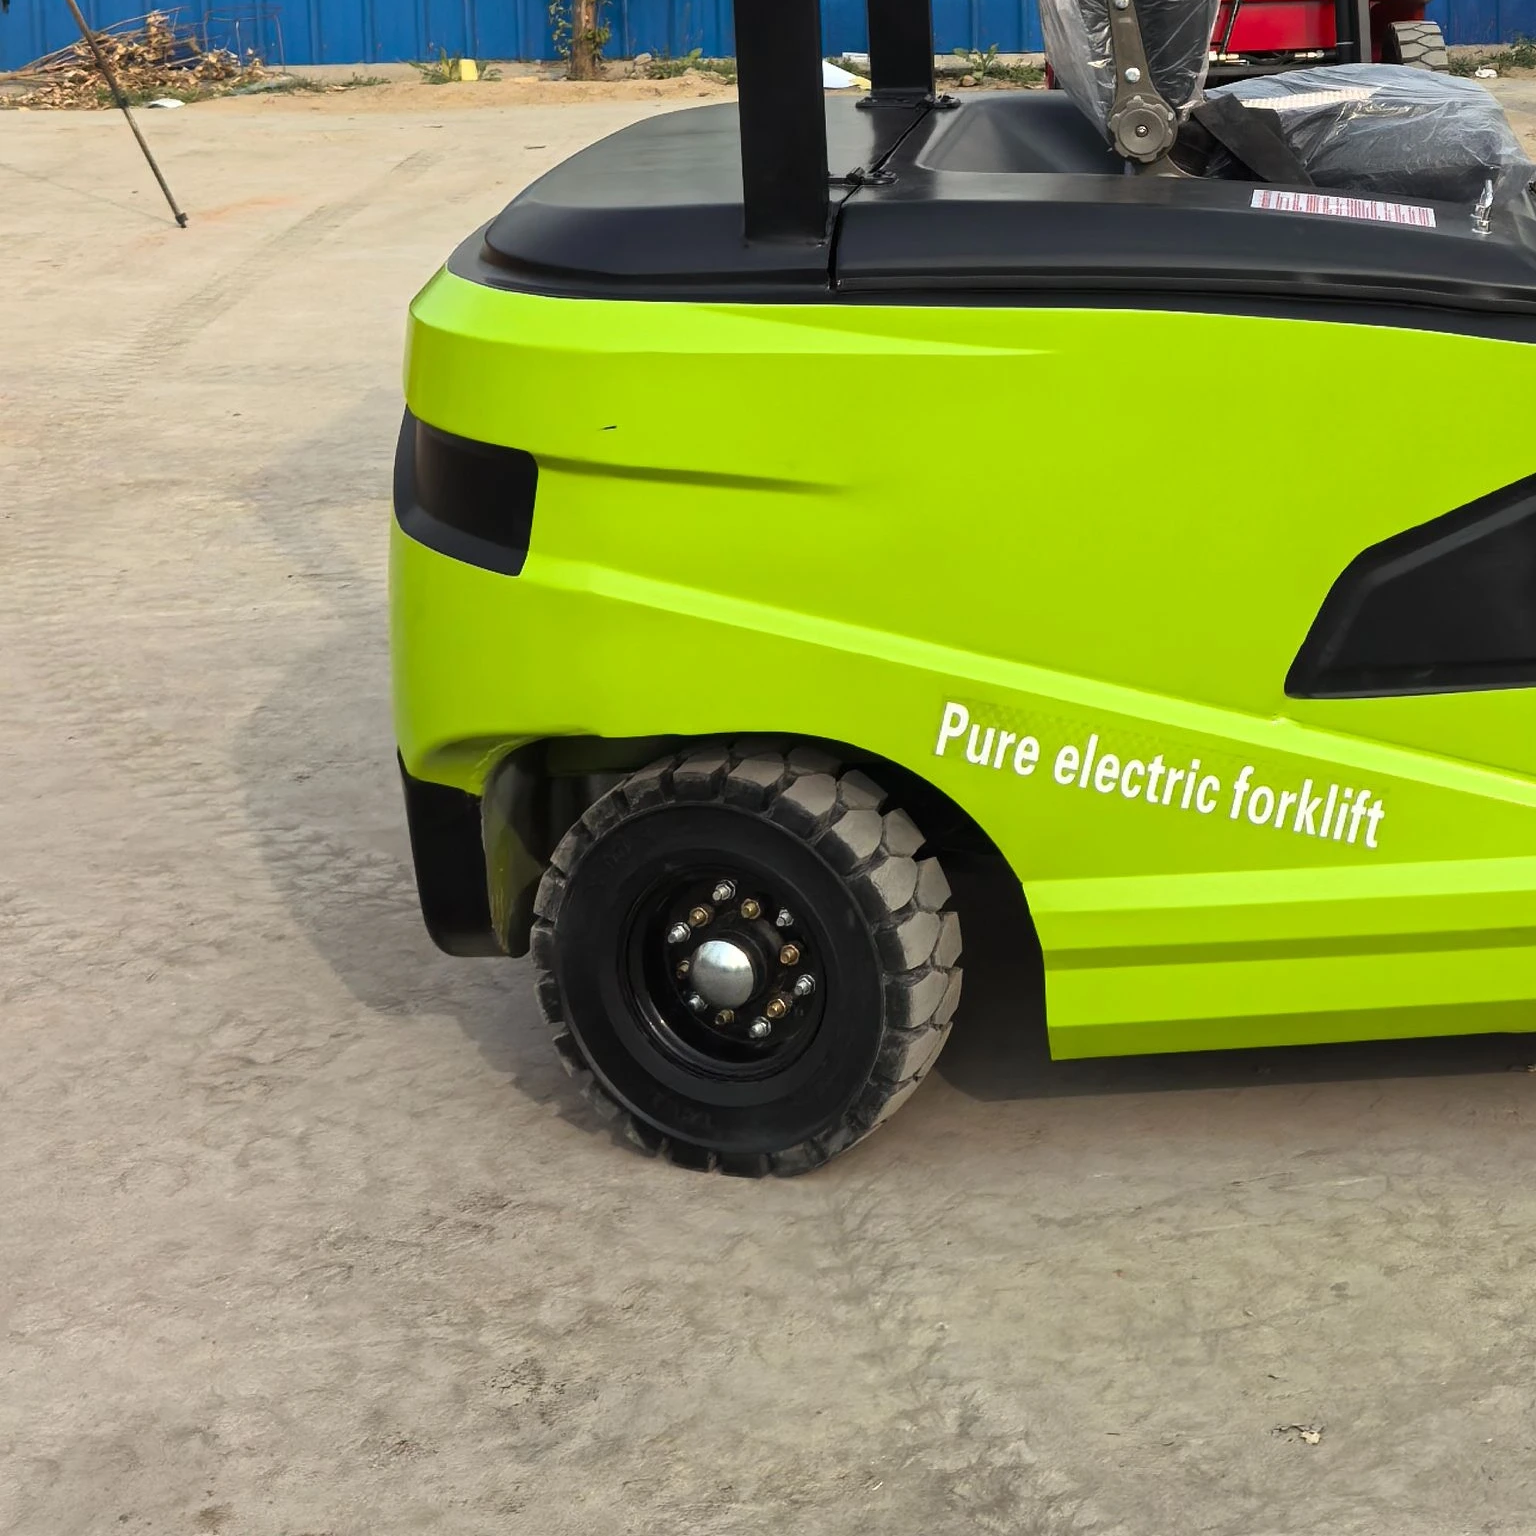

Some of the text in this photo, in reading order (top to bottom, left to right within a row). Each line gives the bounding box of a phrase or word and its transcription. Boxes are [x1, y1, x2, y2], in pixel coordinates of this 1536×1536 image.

[934, 700, 1386, 849] Pure electric forklift
